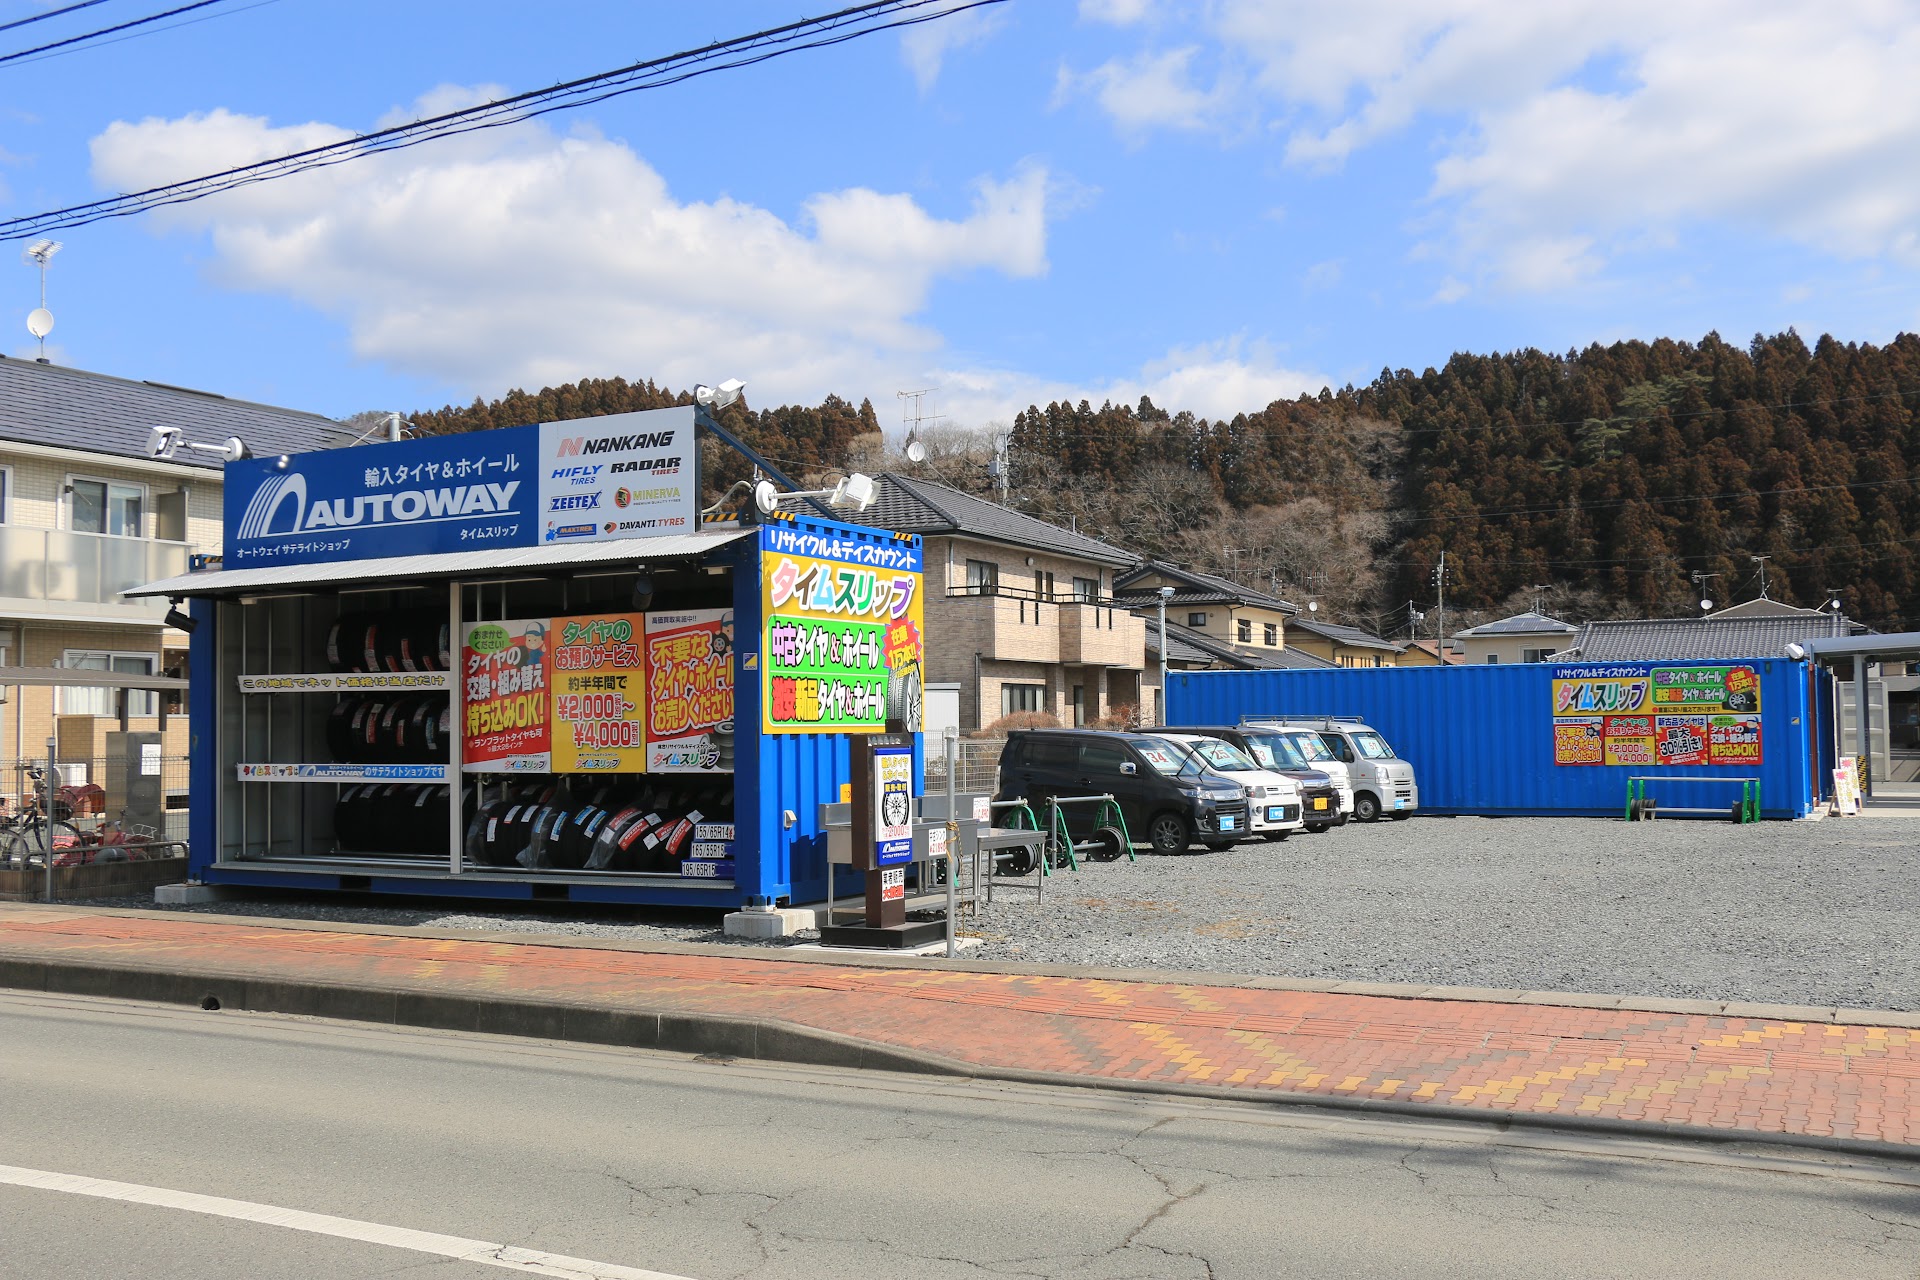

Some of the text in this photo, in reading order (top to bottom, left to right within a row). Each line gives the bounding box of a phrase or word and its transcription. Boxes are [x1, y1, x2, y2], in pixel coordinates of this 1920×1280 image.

[582, 430, 675, 455] NANKANG
[364, 453, 519, 488] 輸入タイヤ&ホイール
[551, 464, 604, 479] HIFLY
[610, 457, 681, 473] RADAR
[651, 468, 679, 476] TIRES
[571, 476, 596, 485] TIRES
[551, 490, 602, 511] ZEETEX
[633, 487, 680, 500] MINERVA
[305, 481, 520, 529] AUTOWAY
[460, 524, 519, 541] タイムスリップ
[559, 525, 593, 534] MAXTREK
[236, 538, 351, 559] オートウェイ サテライトショップ
[771, 530, 916, 570] リサイクル&ディスカウント
[772, 558, 914, 618] タイムスリップ
[474, 630, 503, 639] おまかせ
[563, 619, 632, 645] タイヤの
[474, 640, 504, 650] ください!
[654, 634, 711, 667] 不要な
[468, 646, 521, 674] タイヤの
[556, 644, 640, 669] お預りサービス
[1557, 667, 1647, 678] リサイクル&ディスカウント
[466, 663, 545, 702] 交換・組み替え
[568, 675, 628, 691] 約半年間で
[1558, 681, 1646, 710] タイムスリップ
[466, 692, 545, 738] 持ち込みOK!
[557, 693, 614, 721] ¥2,000
[1611, 718, 1649, 727] タイヤの
[1658, 717, 1704, 726] 新古品タイヤは
[474, 728, 543, 748] ランフラットタイヤも可
[574, 721, 631, 749] ¥4,000
[1557, 728, 1586, 736] 不要な
[1607, 727, 1652, 735] お預りサービス
[1667, 727, 1690, 739] 最大
[1660, 736, 1703, 756] 30%引き!
[1711, 744, 1759, 756] 持ち込みOK!
[505, 759, 547, 770] タイムスリップ
[575, 758, 620, 769] タイムスリップ
[654, 752, 720, 766] タイムスリップ
[1146, 751, 1169, 763] 34
